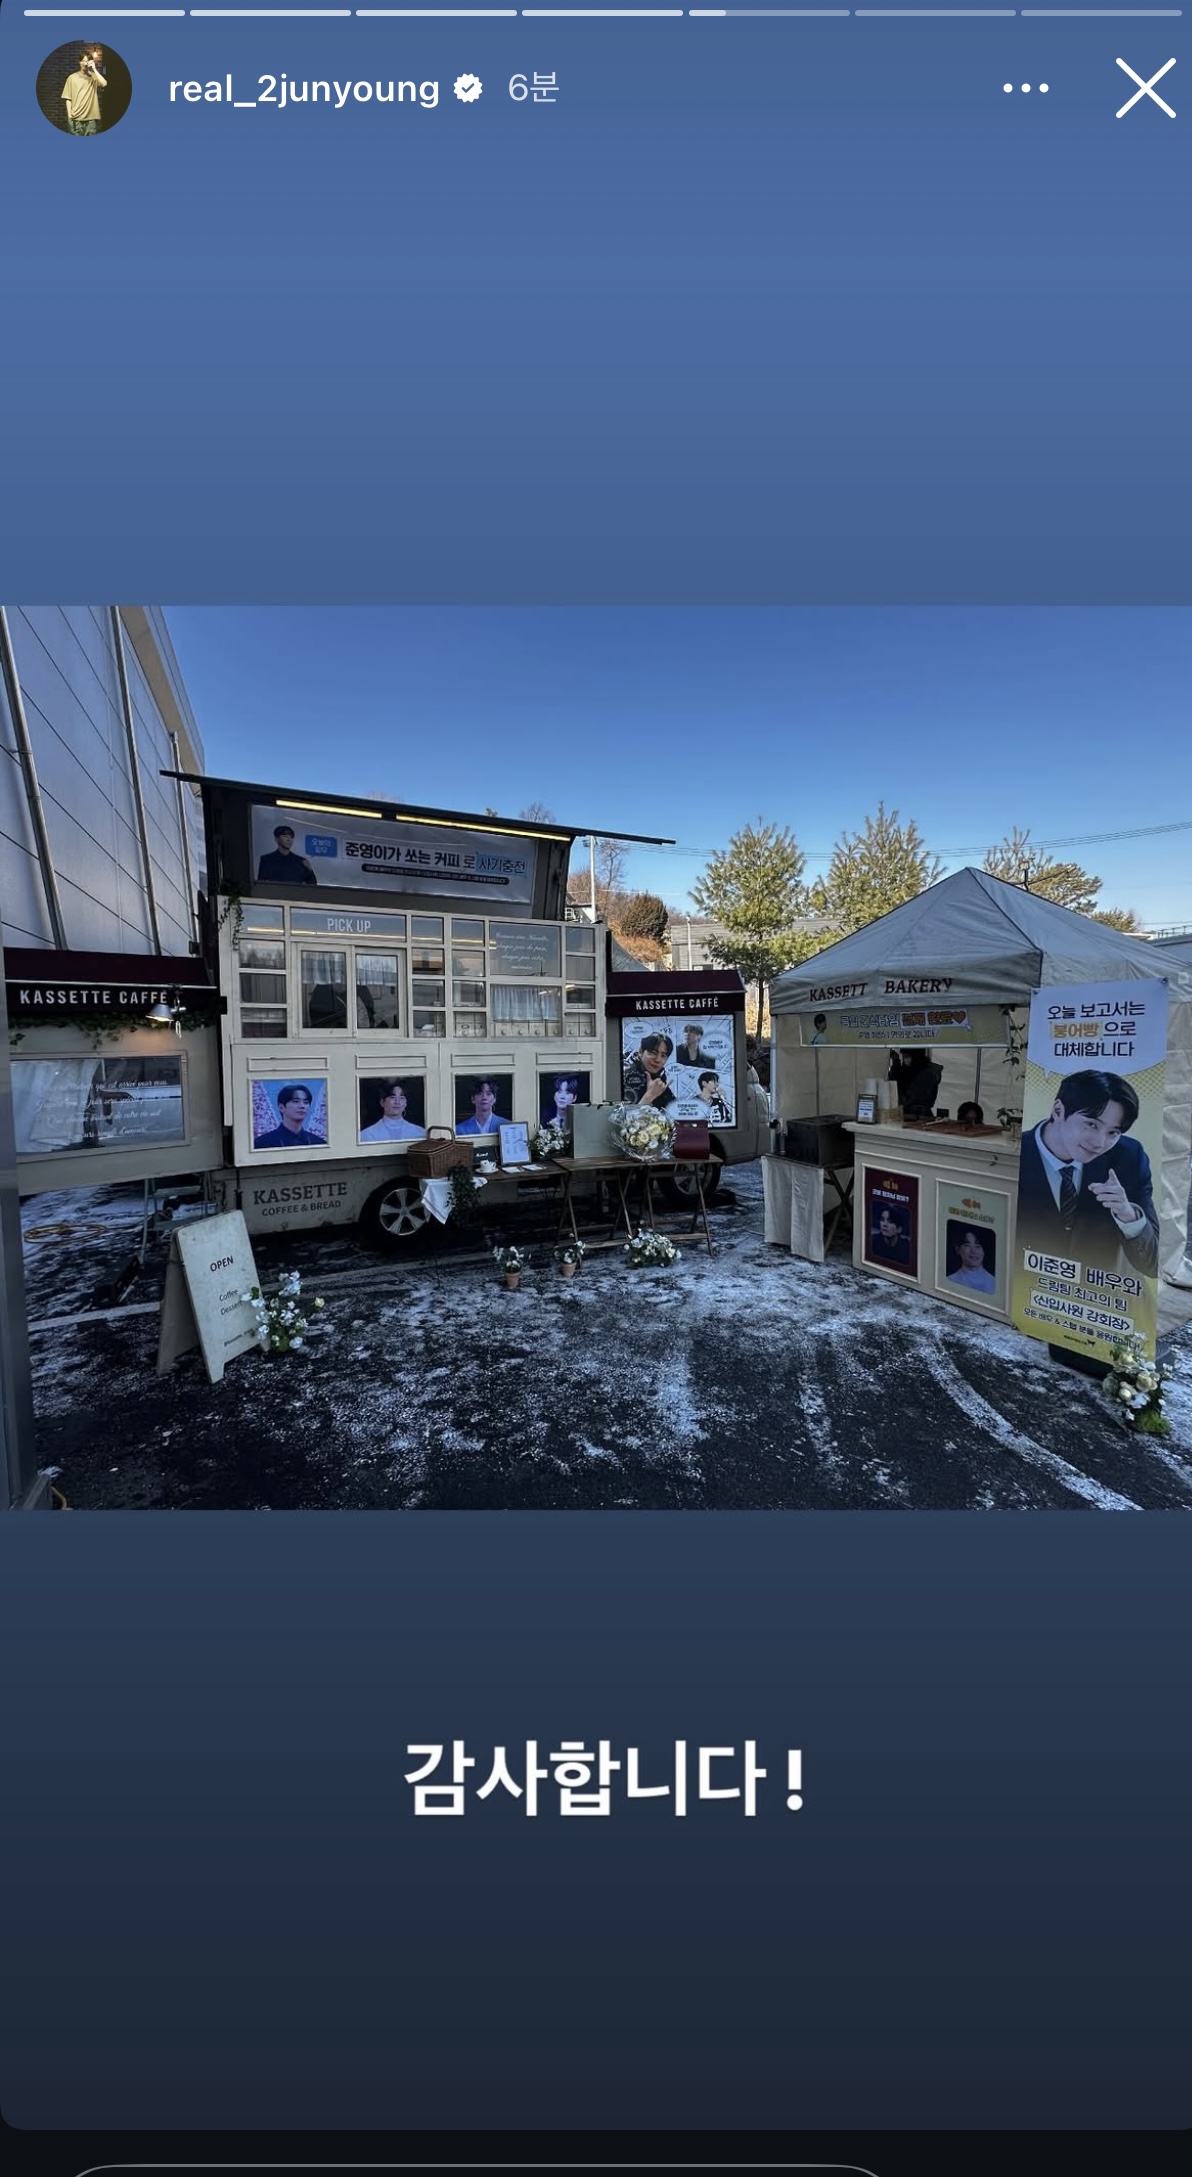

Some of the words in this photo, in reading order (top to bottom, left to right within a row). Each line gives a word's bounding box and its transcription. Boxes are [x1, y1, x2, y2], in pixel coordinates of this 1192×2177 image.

[345, 841, 401, 862] 준영이가
[404, 848, 431, 865] 쏘는
[479, 857, 525, 874] 사기충전
[327, 917, 353, 932] PICK
[356, 919, 371, 933] UP
[20, 989, 112, 1005] KASSETTE
[809, 982, 868, 1001] KASSETT
[884, 977, 953, 994] BAKERY
[635, 999, 685, 1011] KASSETTE
[1047, 1005, 1077, 1020] 오늘
[1080, 1001, 1146, 1017] 보고서는
[1103, 1021, 1137, 1037] 으로
[1054, 1042, 1135, 1057] 대체합니다
[253, 1182, 348, 1205] KASSETTE
[262, 1205, 299, 1217] COFFEE
[301, 1204, 309, 1212] &
[310, 1200, 342, 1211] BREAD
[209, 1255, 234, 1272] OPEN
[1028, 1253, 1076, 1279] 이준영
[1086, 1267, 1142, 1297] 배우와
[219, 1288, 238, 1302] Coffee
[1038, 1277, 1071, 1296] 드림팀
[1074, 1287, 1111, 1307] 최고의
